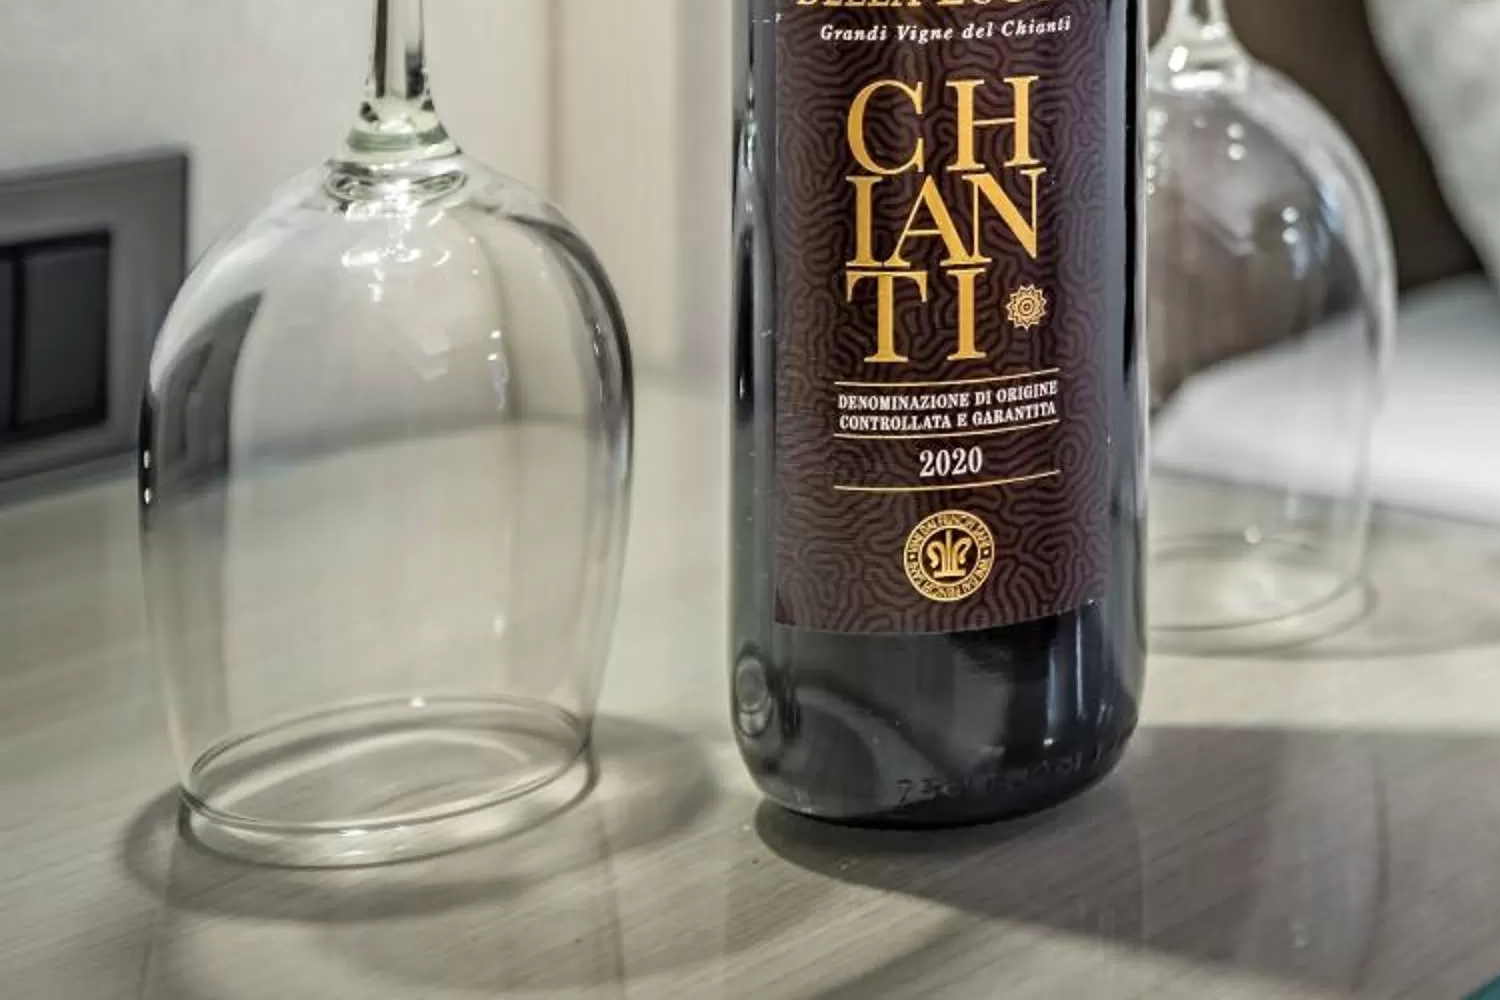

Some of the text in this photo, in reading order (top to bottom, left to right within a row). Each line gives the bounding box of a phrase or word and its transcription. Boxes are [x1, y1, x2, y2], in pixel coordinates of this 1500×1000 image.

[820, 15, 1072, 44] Grandi Vigne del Chianti
[837, 379, 1059, 411] DENOMINAZIONE DI ORIGINE
[839, 401, 1057, 432] CONTROLLATA E GARANTITA
[919, 445, 983, 478] 2020
